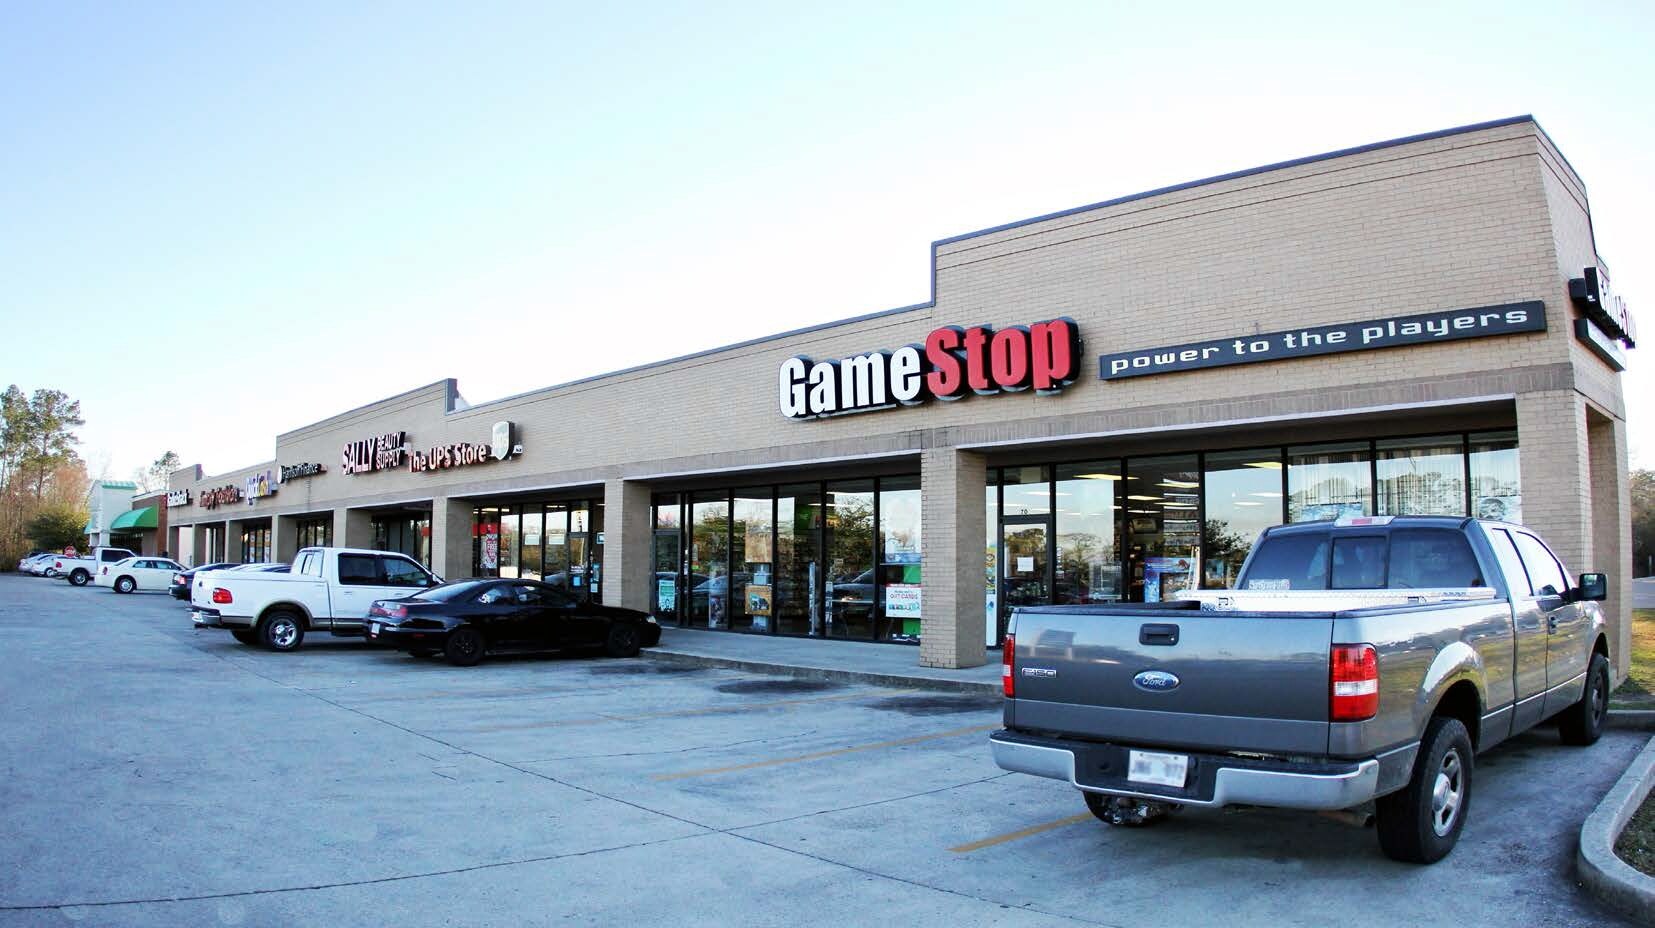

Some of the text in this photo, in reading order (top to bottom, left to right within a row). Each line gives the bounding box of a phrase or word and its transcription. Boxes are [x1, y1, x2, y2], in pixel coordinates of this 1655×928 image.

[1111, 309, 1528, 374] power to the players
[779, 318, 1075, 419] GameStop
[377, 432, 402, 449] BEAUTY
[343, 438, 375, 474] SALLY
[376, 448, 401, 470] SUPPLY
[408, 442, 487, 472] The UPS Store
[1142, 674, 1168, 687] Ford
